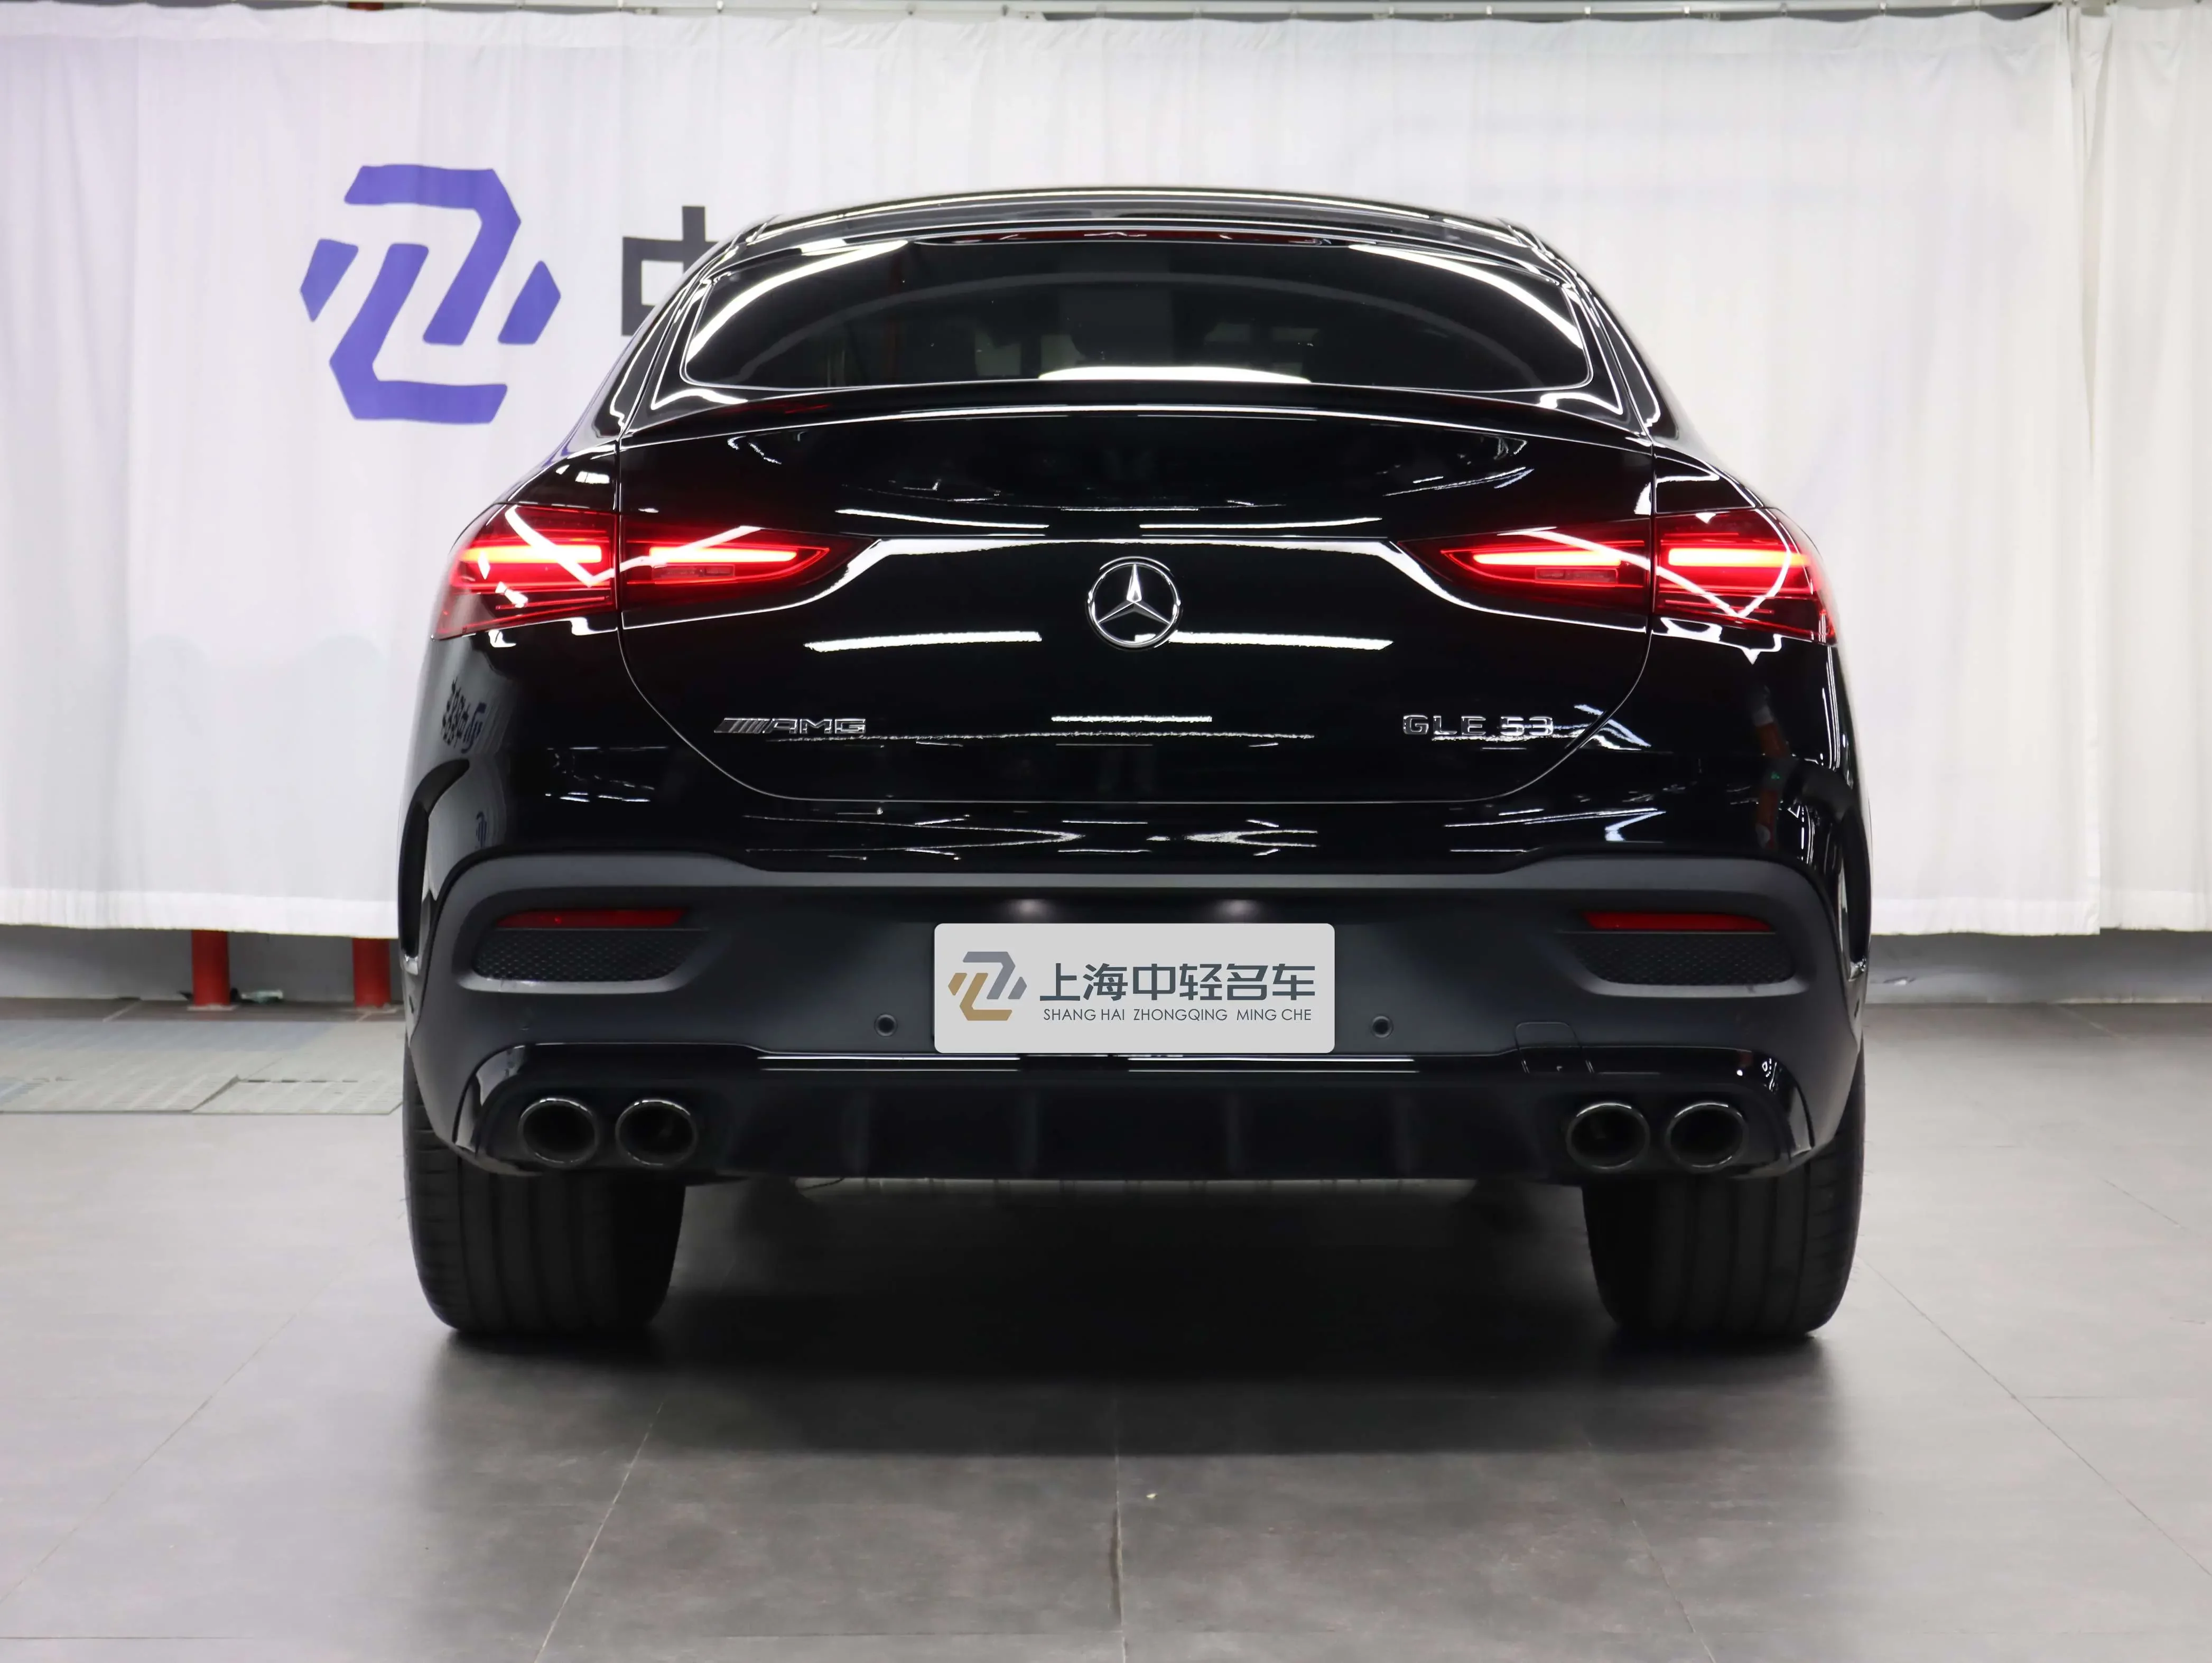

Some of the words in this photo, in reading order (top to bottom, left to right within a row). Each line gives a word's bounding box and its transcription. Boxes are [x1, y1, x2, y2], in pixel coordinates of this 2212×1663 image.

[767, 718, 866, 733] AMG
[1403, 714, 1486, 736] GLE
[1500, 716, 1554, 736] 53
[1039, 963, 1315, 1001] 上海中轻名车
[1044, 1008, 1096, 1021] SHANG
[1101, 1008, 1124, 1021] HAI
[1133, 1008, 1228, 1021] ZHONGQING
[1237, 1008, 1277, 1021] MING
[1281, 1008, 1312, 1021] CHE
